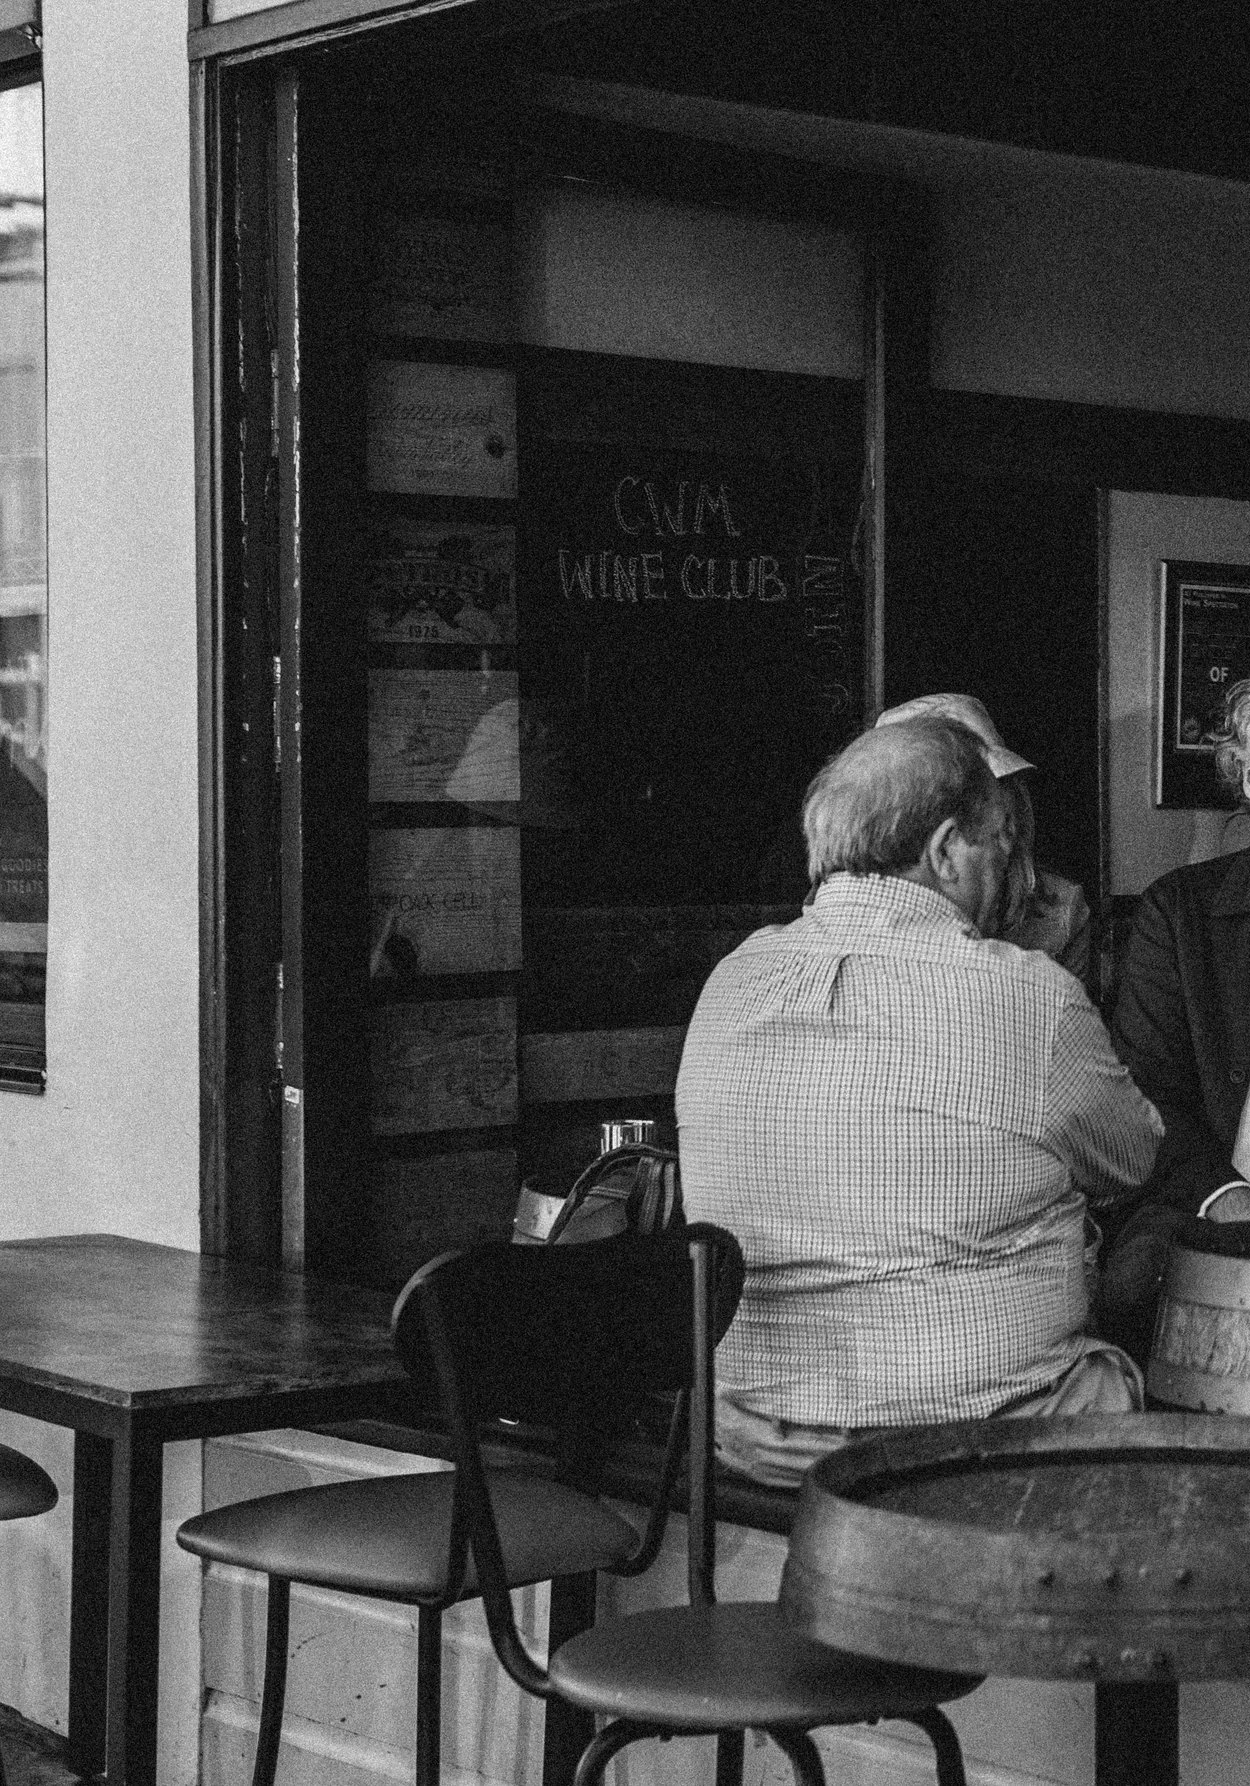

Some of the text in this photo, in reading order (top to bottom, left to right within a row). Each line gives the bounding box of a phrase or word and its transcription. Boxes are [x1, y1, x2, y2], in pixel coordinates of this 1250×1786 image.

[613, 474, 741, 538] CWM
[557, 548, 788, 604] WINE CLUB
[1209, 666, 1230, 683] OF
